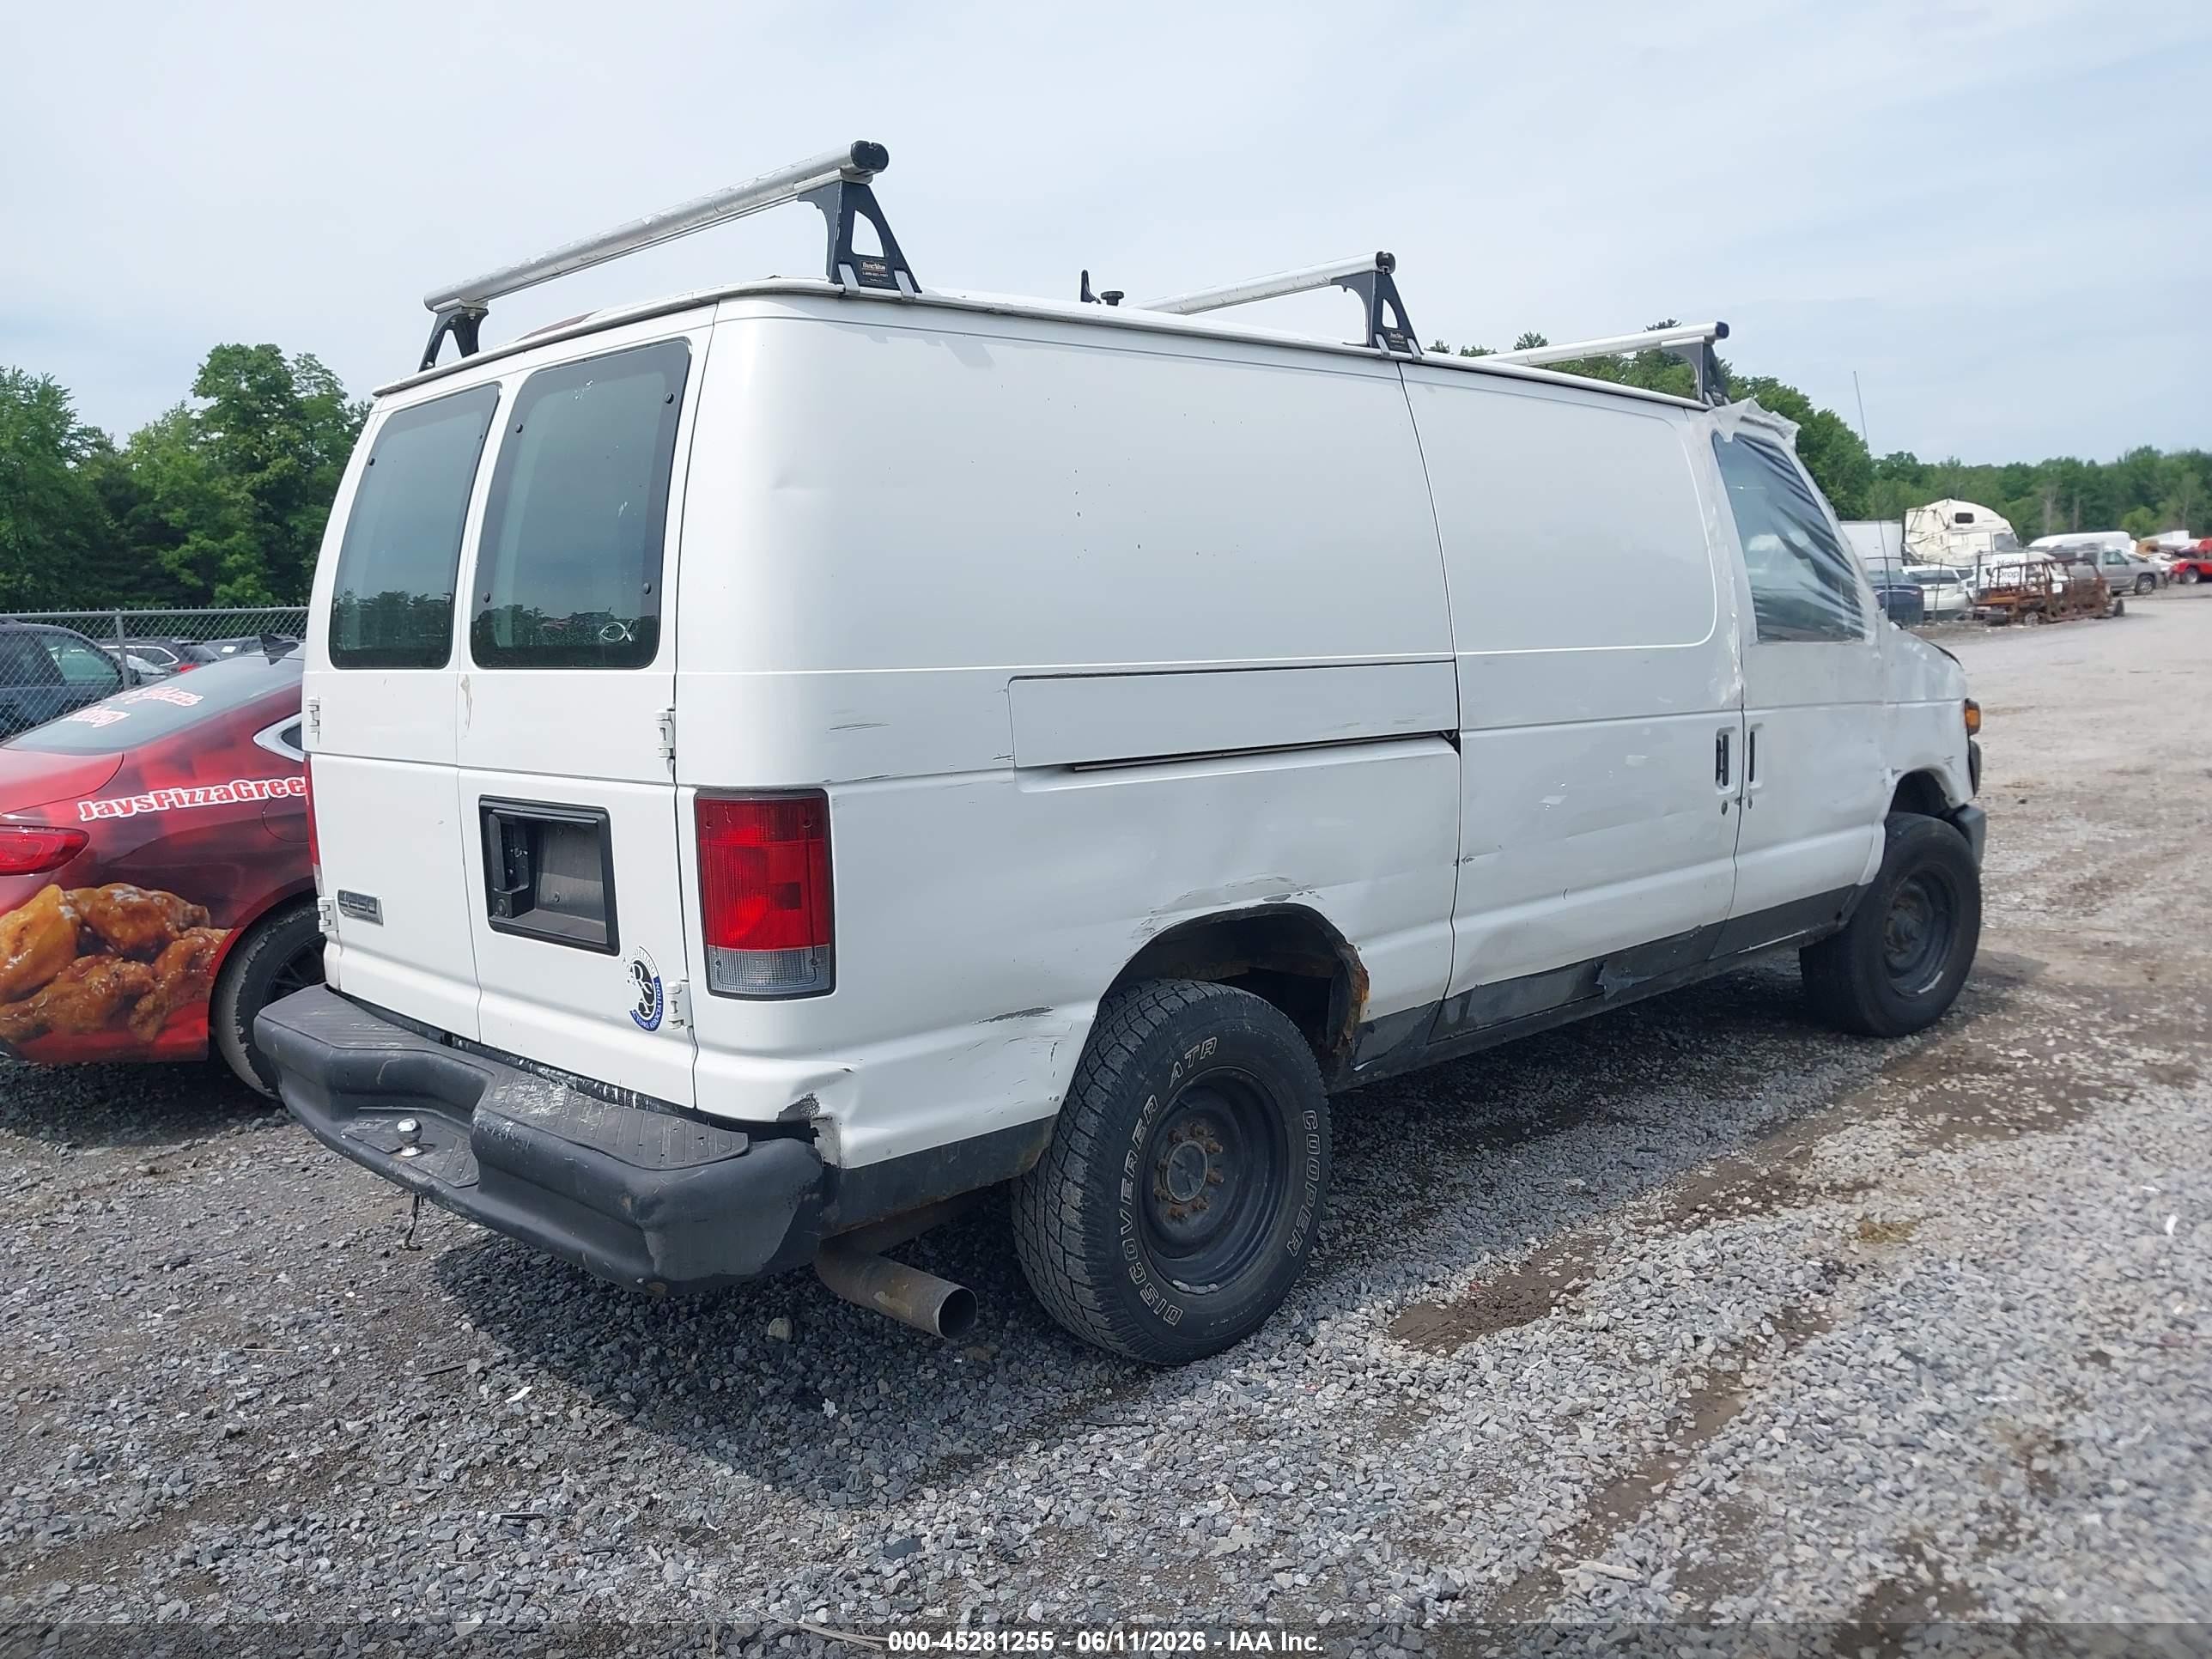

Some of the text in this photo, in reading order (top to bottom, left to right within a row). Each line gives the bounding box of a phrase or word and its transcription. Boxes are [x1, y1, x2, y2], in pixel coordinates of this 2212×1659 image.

[1119, 1036, 1218, 1326] DISCOVERER ATR
[1286, 1109, 1321, 1257] COOPER
